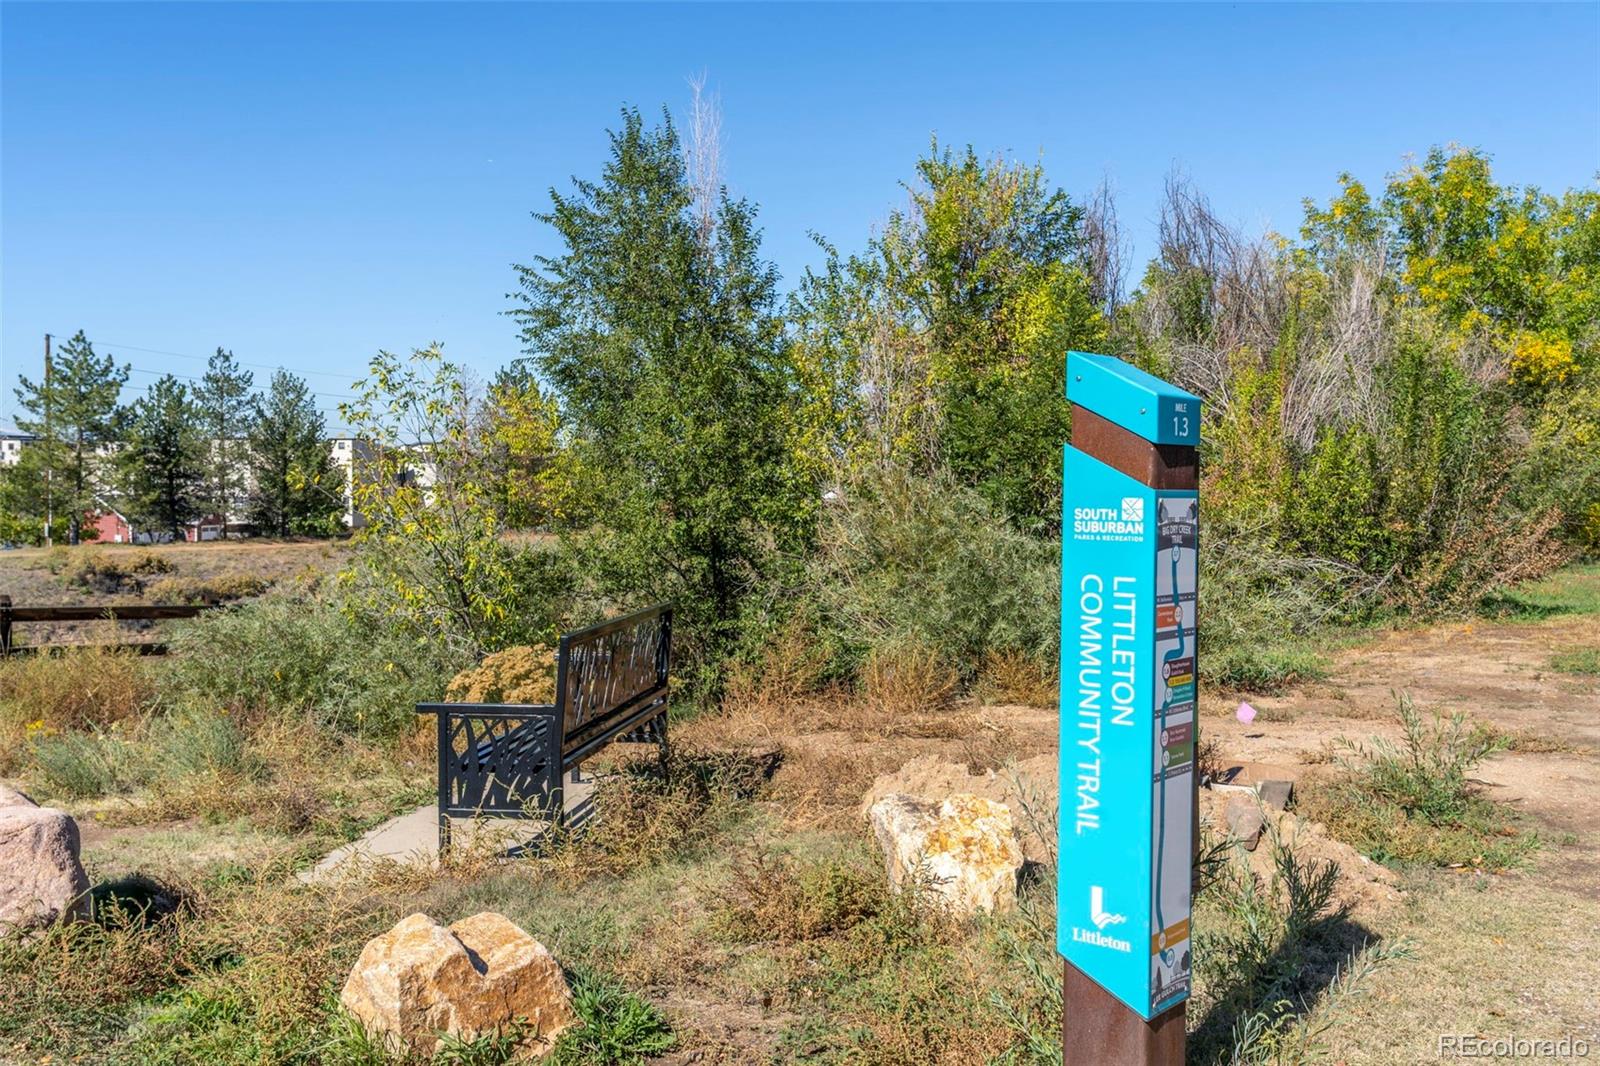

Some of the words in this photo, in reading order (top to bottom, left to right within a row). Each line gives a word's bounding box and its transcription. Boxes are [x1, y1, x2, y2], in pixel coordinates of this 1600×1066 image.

[1175, 403, 1187, 412] MILE
[1173, 417, 1188, 436] 1.3
[1074, 508, 1117, 520] SOUTH
[1074, 520, 1144, 534] SUBURBAN
[1111, 576, 1136, 726] LITTLETON
[1077, 574, 1103, 755] COMMUNITY
[1076, 758, 1100, 835] TRAIL
[1073, 927, 1131, 952] Littleton
